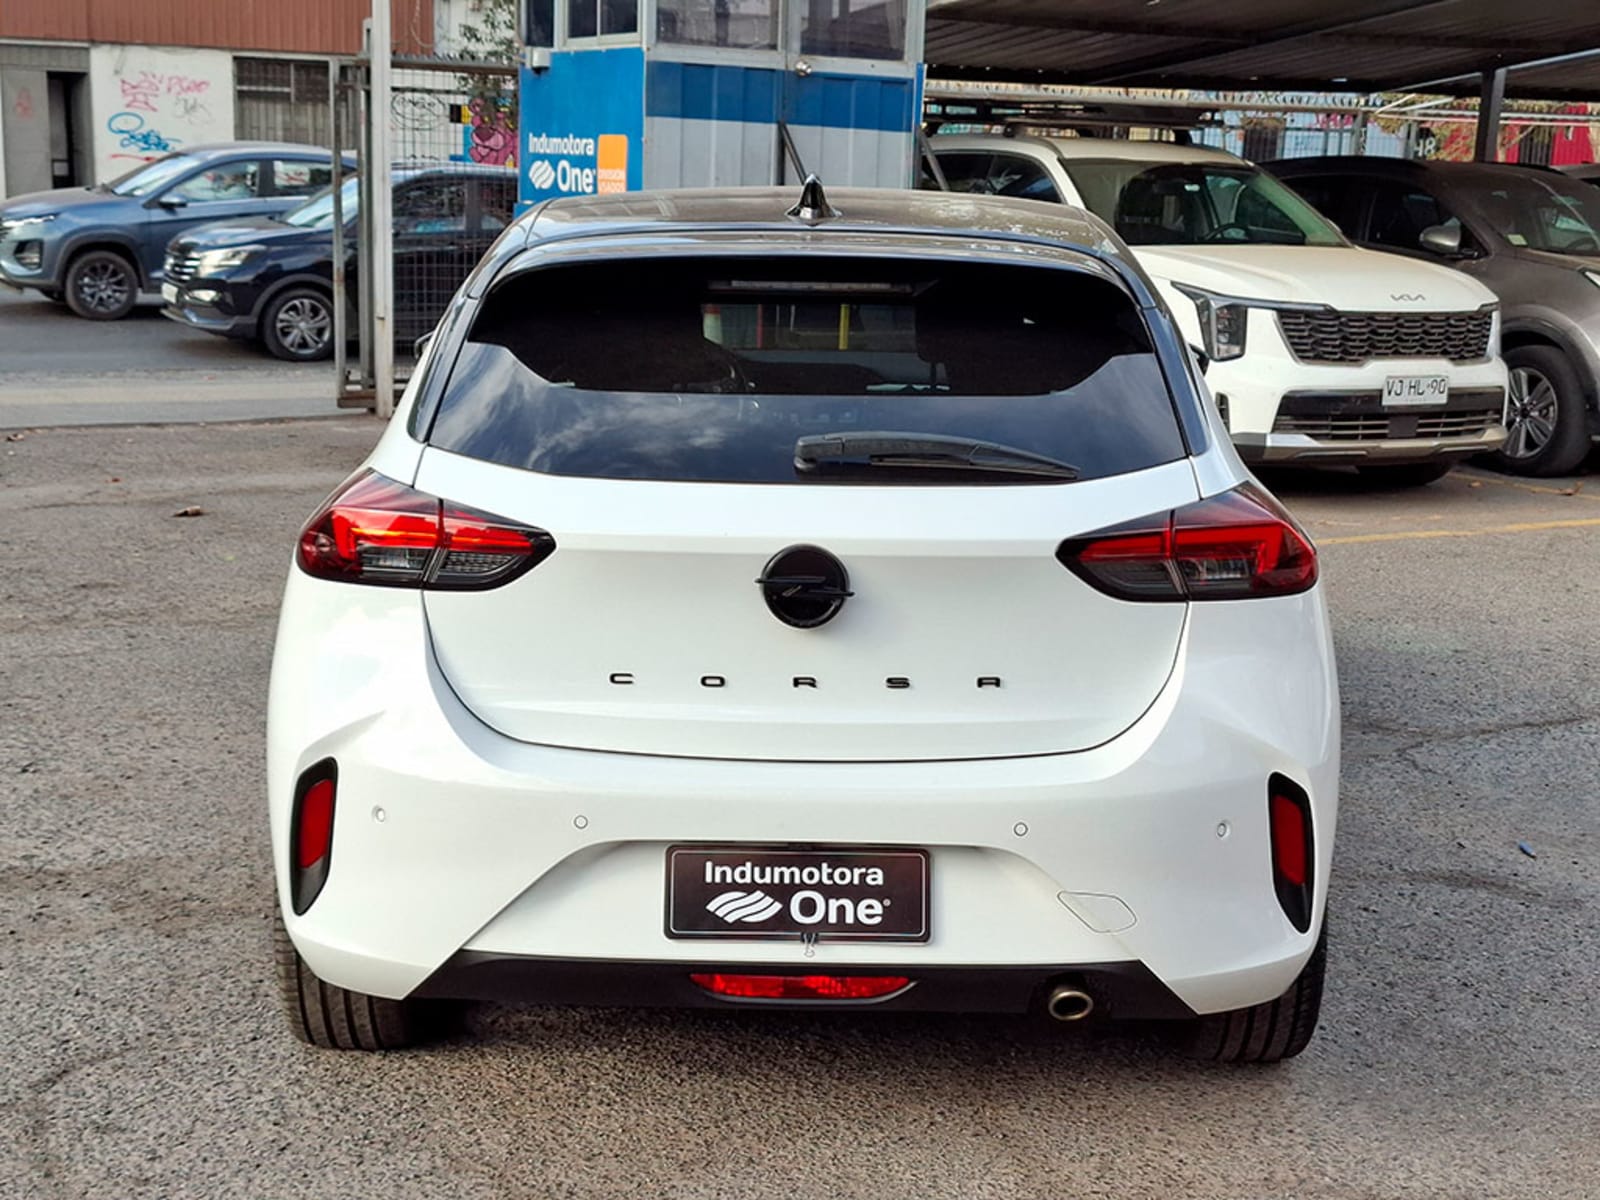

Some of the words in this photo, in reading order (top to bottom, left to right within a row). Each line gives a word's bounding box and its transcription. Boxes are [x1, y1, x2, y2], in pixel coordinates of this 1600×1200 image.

[528, 132, 594, 155] Indumotora
[556, 159, 594, 193] One
[609, 673, 1001, 688] CORSA
[704, 861, 884, 885] Indumotora
[789, 890, 884, 925] One
